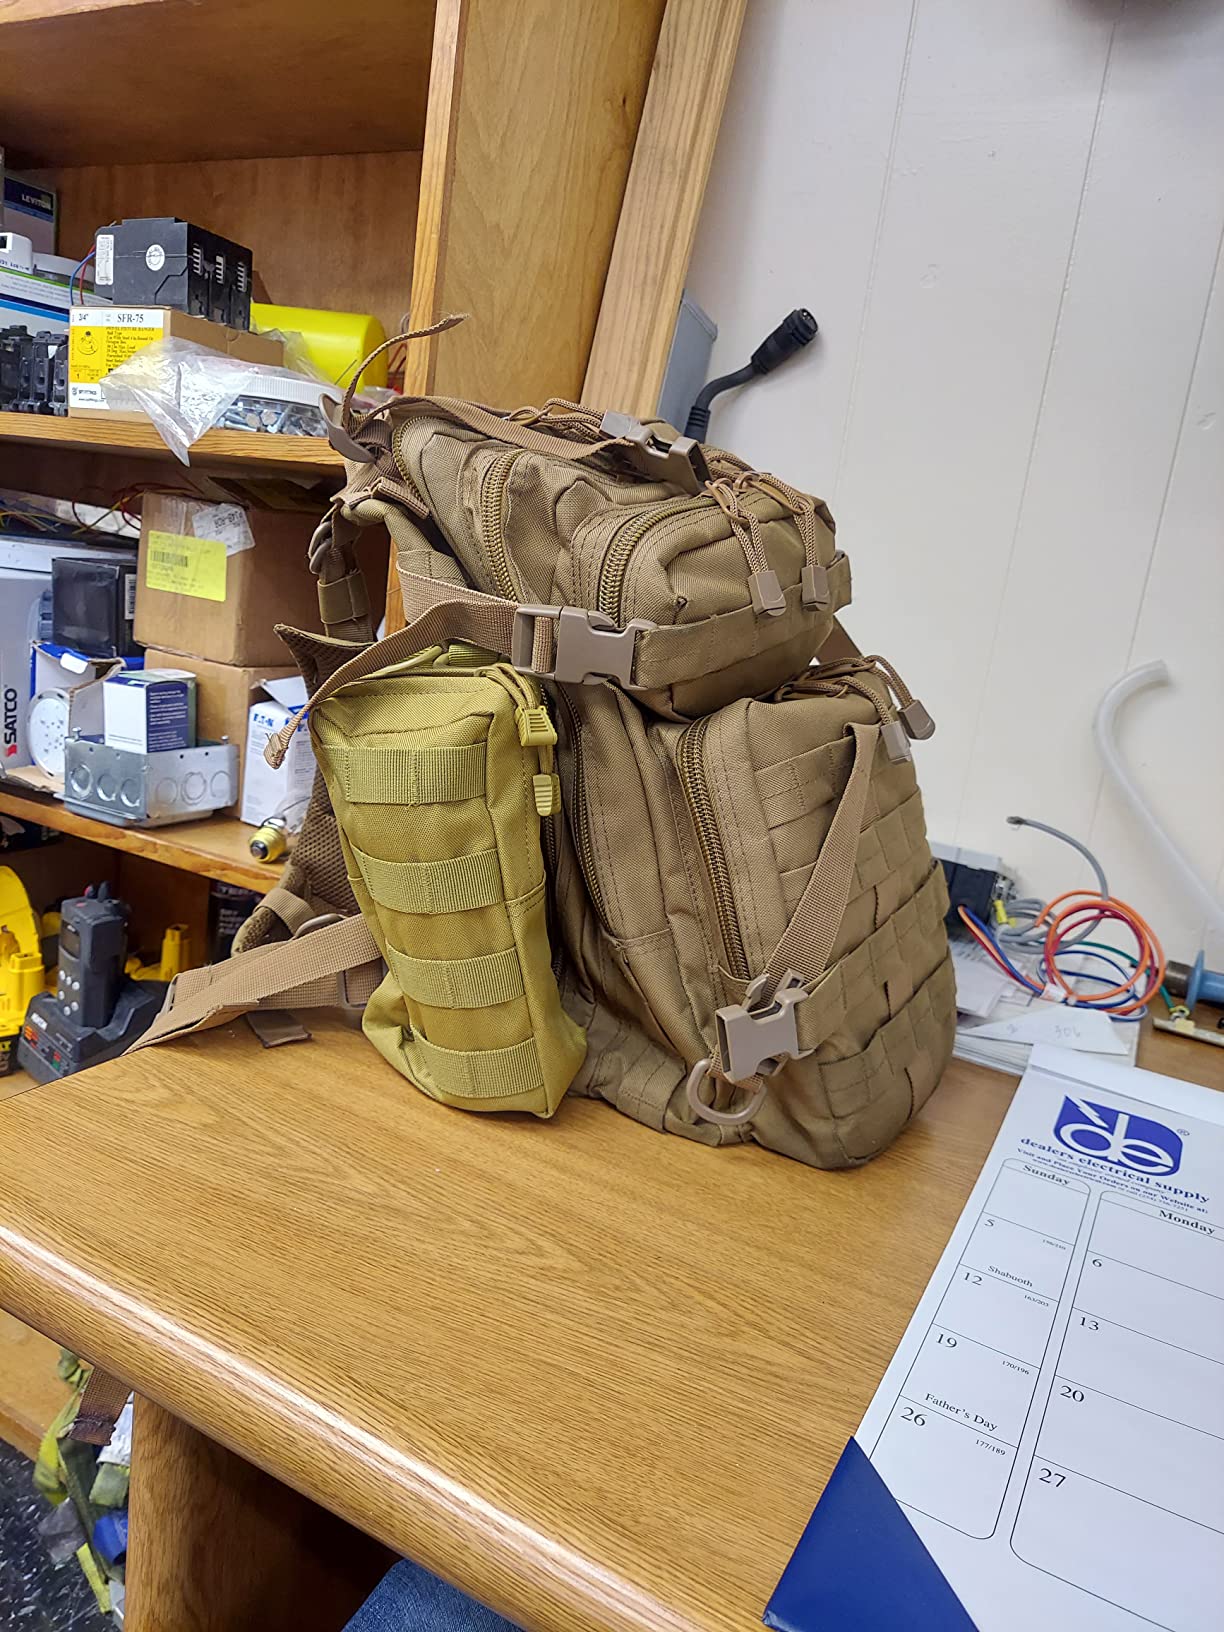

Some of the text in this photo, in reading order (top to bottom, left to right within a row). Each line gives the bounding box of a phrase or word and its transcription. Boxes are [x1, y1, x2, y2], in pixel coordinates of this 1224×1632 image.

[117, 313, 144, 323] SFR-75
[4, 688, 17, 744] SATCO
[1017, 1148, 1035, 1157] Visit
[1054, 1161, 1074, 1170] Place
[1077, 1168, 1097, 1177] Your
[1099, 1175, 1129, 1188] Orders
[1160, 1194, 1194, 1209] Website
[1020, 1137, 1210, 1203] dealers electrical supply
[1023, 1164, 1070, 1185] Sunday
[983, 1218, 996, 1228] 5
[1159, 1209, 1215, 1235] Monday
[1092, 1258, 1103, 1268] 6
[963, 1272, 983, 1286] 12
[987, 1265, 1033, 1288] Shabuoth
[1079, 1316, 1099, 1331] 13
[935, 1333, 958, 1348] 19
[1002, 1360, 1030, 1375] 170/196
[1059, 1385, 1085, 1403] 20
[900, 1406, 928, 1427] 26
[925, 1392, 998, 1432] Father's Day
[975, 1439, 1006, 1456] 177/189
[1038, 1467, 1067, 1488] 27
